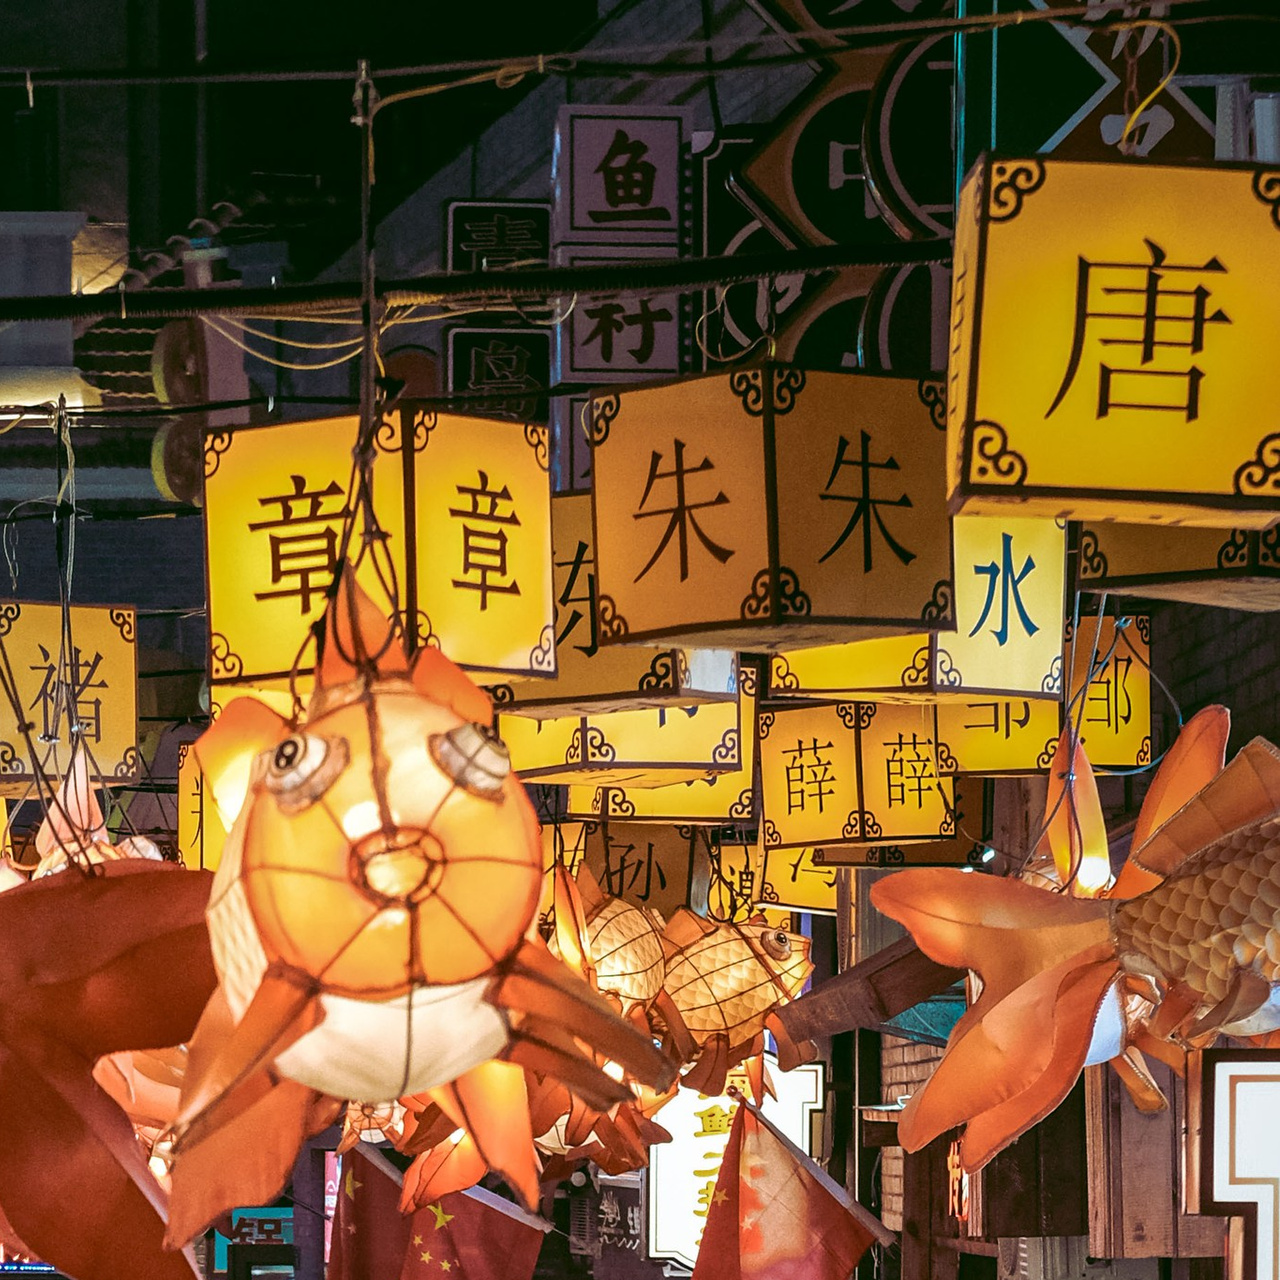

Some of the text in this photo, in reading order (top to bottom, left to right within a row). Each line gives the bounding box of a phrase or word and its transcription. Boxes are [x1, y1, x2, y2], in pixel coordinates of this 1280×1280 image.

[1043, 236, 1231, 423] 唐
[248, 474, 352, 616] 章
[449, 470, 522, 612] 章
[633, 437, 735, 584] 朱
[819, 430, 916, 576] 朱
[967, 532, 1041, 647] 水
[28, 642, 110, 745] 褚
[781, 737, 839, 817] 薛
[883, 732, 939, 811] 薛
[598, 841, 668, 902] 孙
